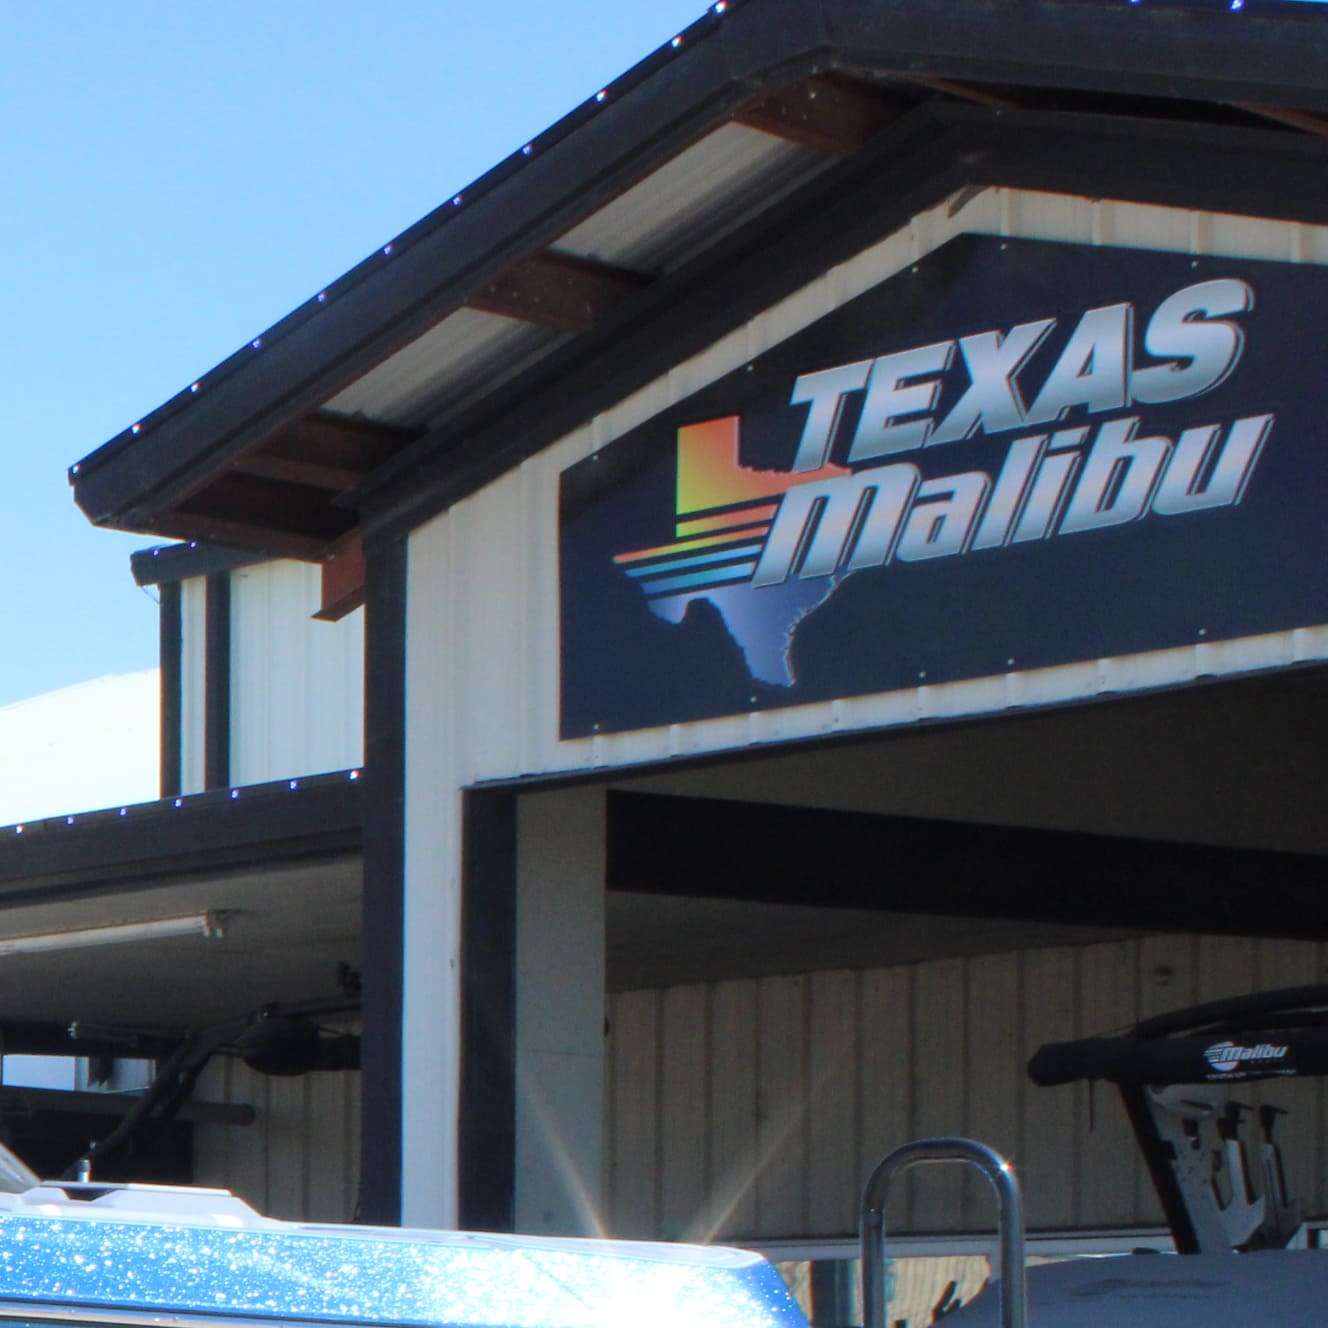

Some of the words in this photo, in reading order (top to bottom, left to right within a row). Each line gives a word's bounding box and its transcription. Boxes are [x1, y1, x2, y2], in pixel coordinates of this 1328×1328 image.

[789, 278, 1255, 473] TEXAS
[752, 413, 1275, 588] Malibu
[1220, 1044, 1288, 1060] Malibu
